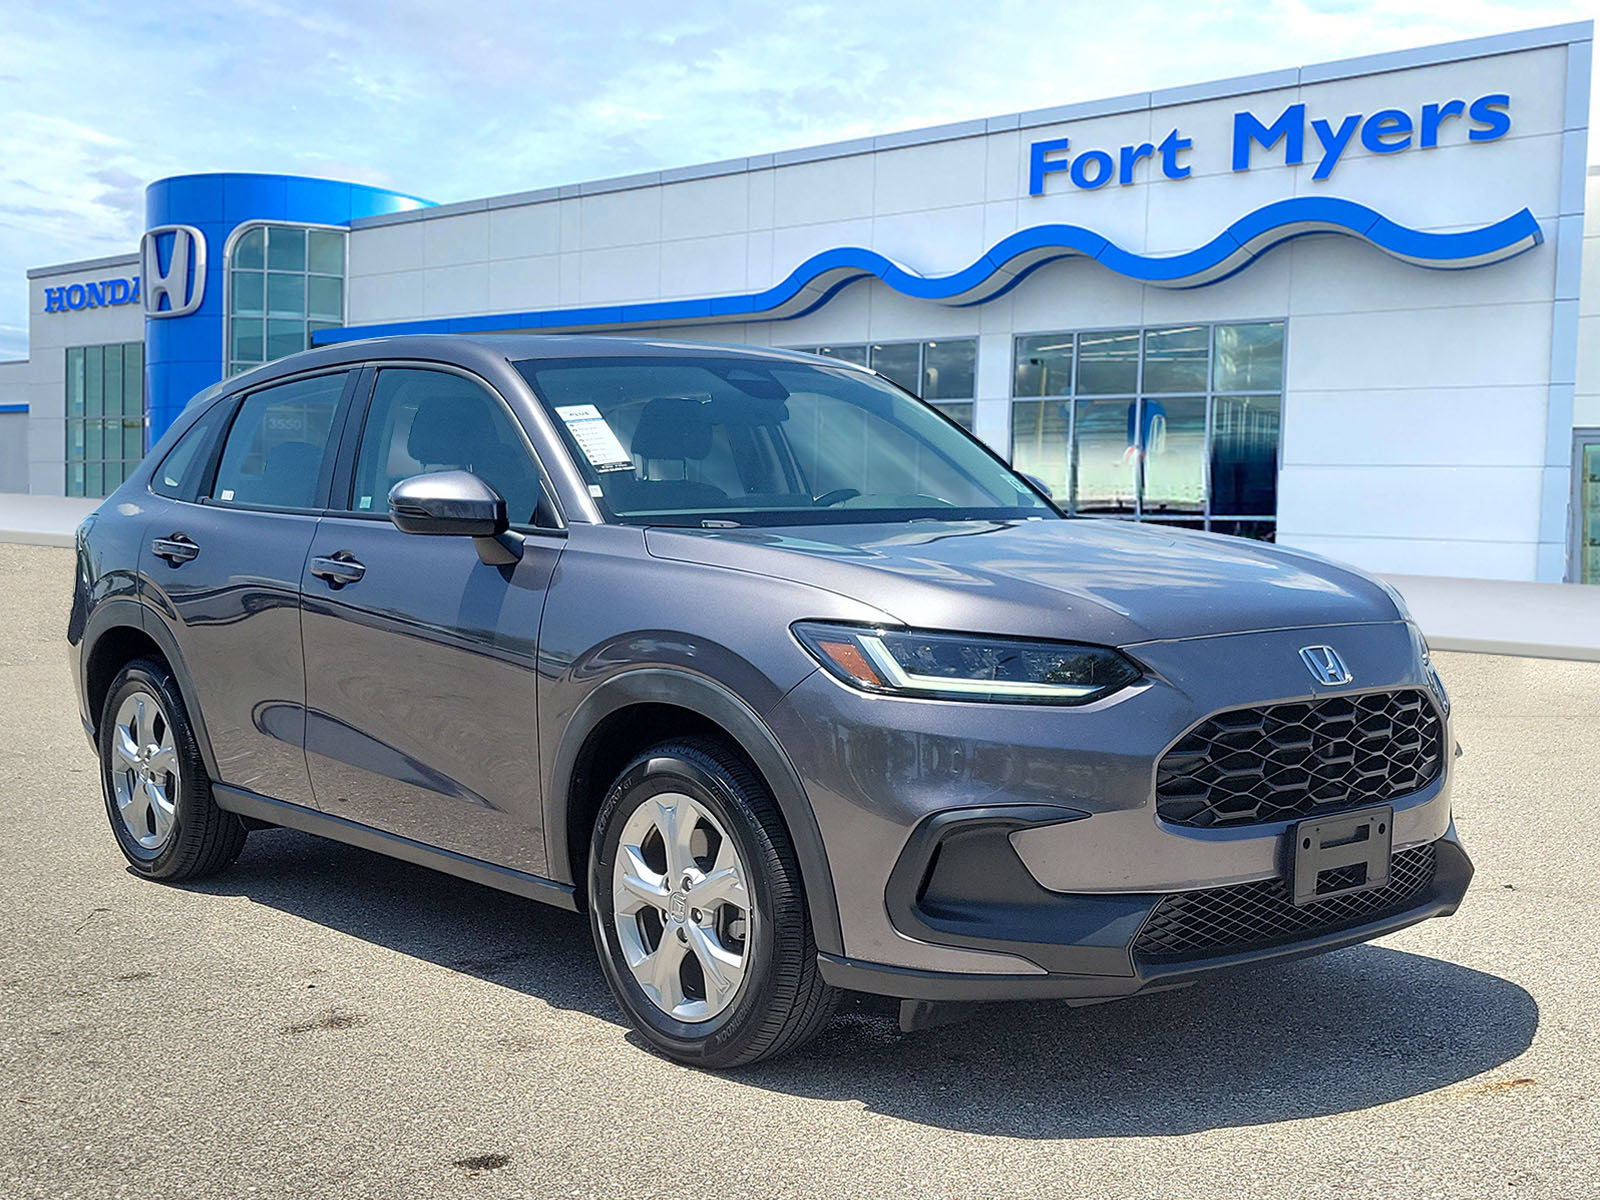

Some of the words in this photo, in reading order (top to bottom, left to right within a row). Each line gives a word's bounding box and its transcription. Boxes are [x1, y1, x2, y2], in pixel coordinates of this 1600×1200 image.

[1028, 128, 1192, 197] Fort
[1232, 93, 1512, 182] Myers
[268, 418, 302, 430] 3550
